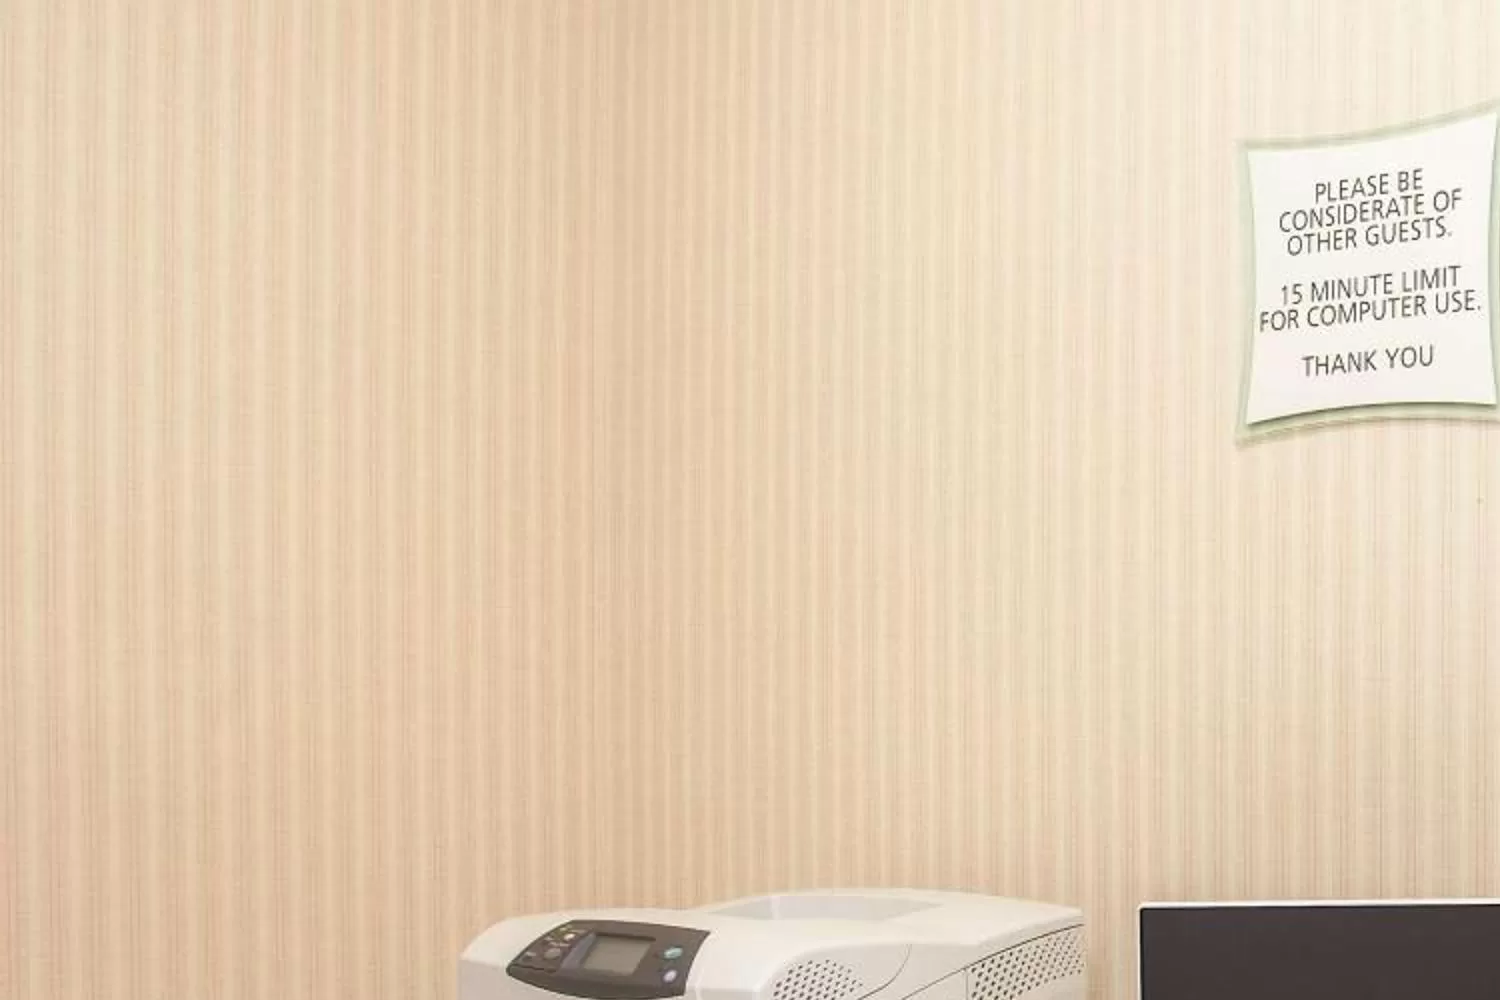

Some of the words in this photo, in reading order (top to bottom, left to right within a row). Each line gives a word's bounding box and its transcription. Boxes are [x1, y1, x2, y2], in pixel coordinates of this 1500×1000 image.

[1315, 173, 1389, 203] PLEASE
[1397, 168, 1423, 192] BE
[1279, 193, 1425, 233] CONSIDERATE
[1433, 188, 1462, 212] OF
[1287, 227, 1357, 256] OTHER
[1365, 215, 1452, 247] GUESTS.
[1281, 283, 1303, 306] 15
[1311, 273, 1393, 303] MINUTE
[1401, 265, 1461, 292] LIMIT
[1260, 310, 1300, 332] FOR
[1306, 295, 1427, 327] COMPUTER
[1435, 289, 1482, 314] USE.
[1302, 350, 1377, 377] THANK
[1385, 344, 1435, 369] YOU
